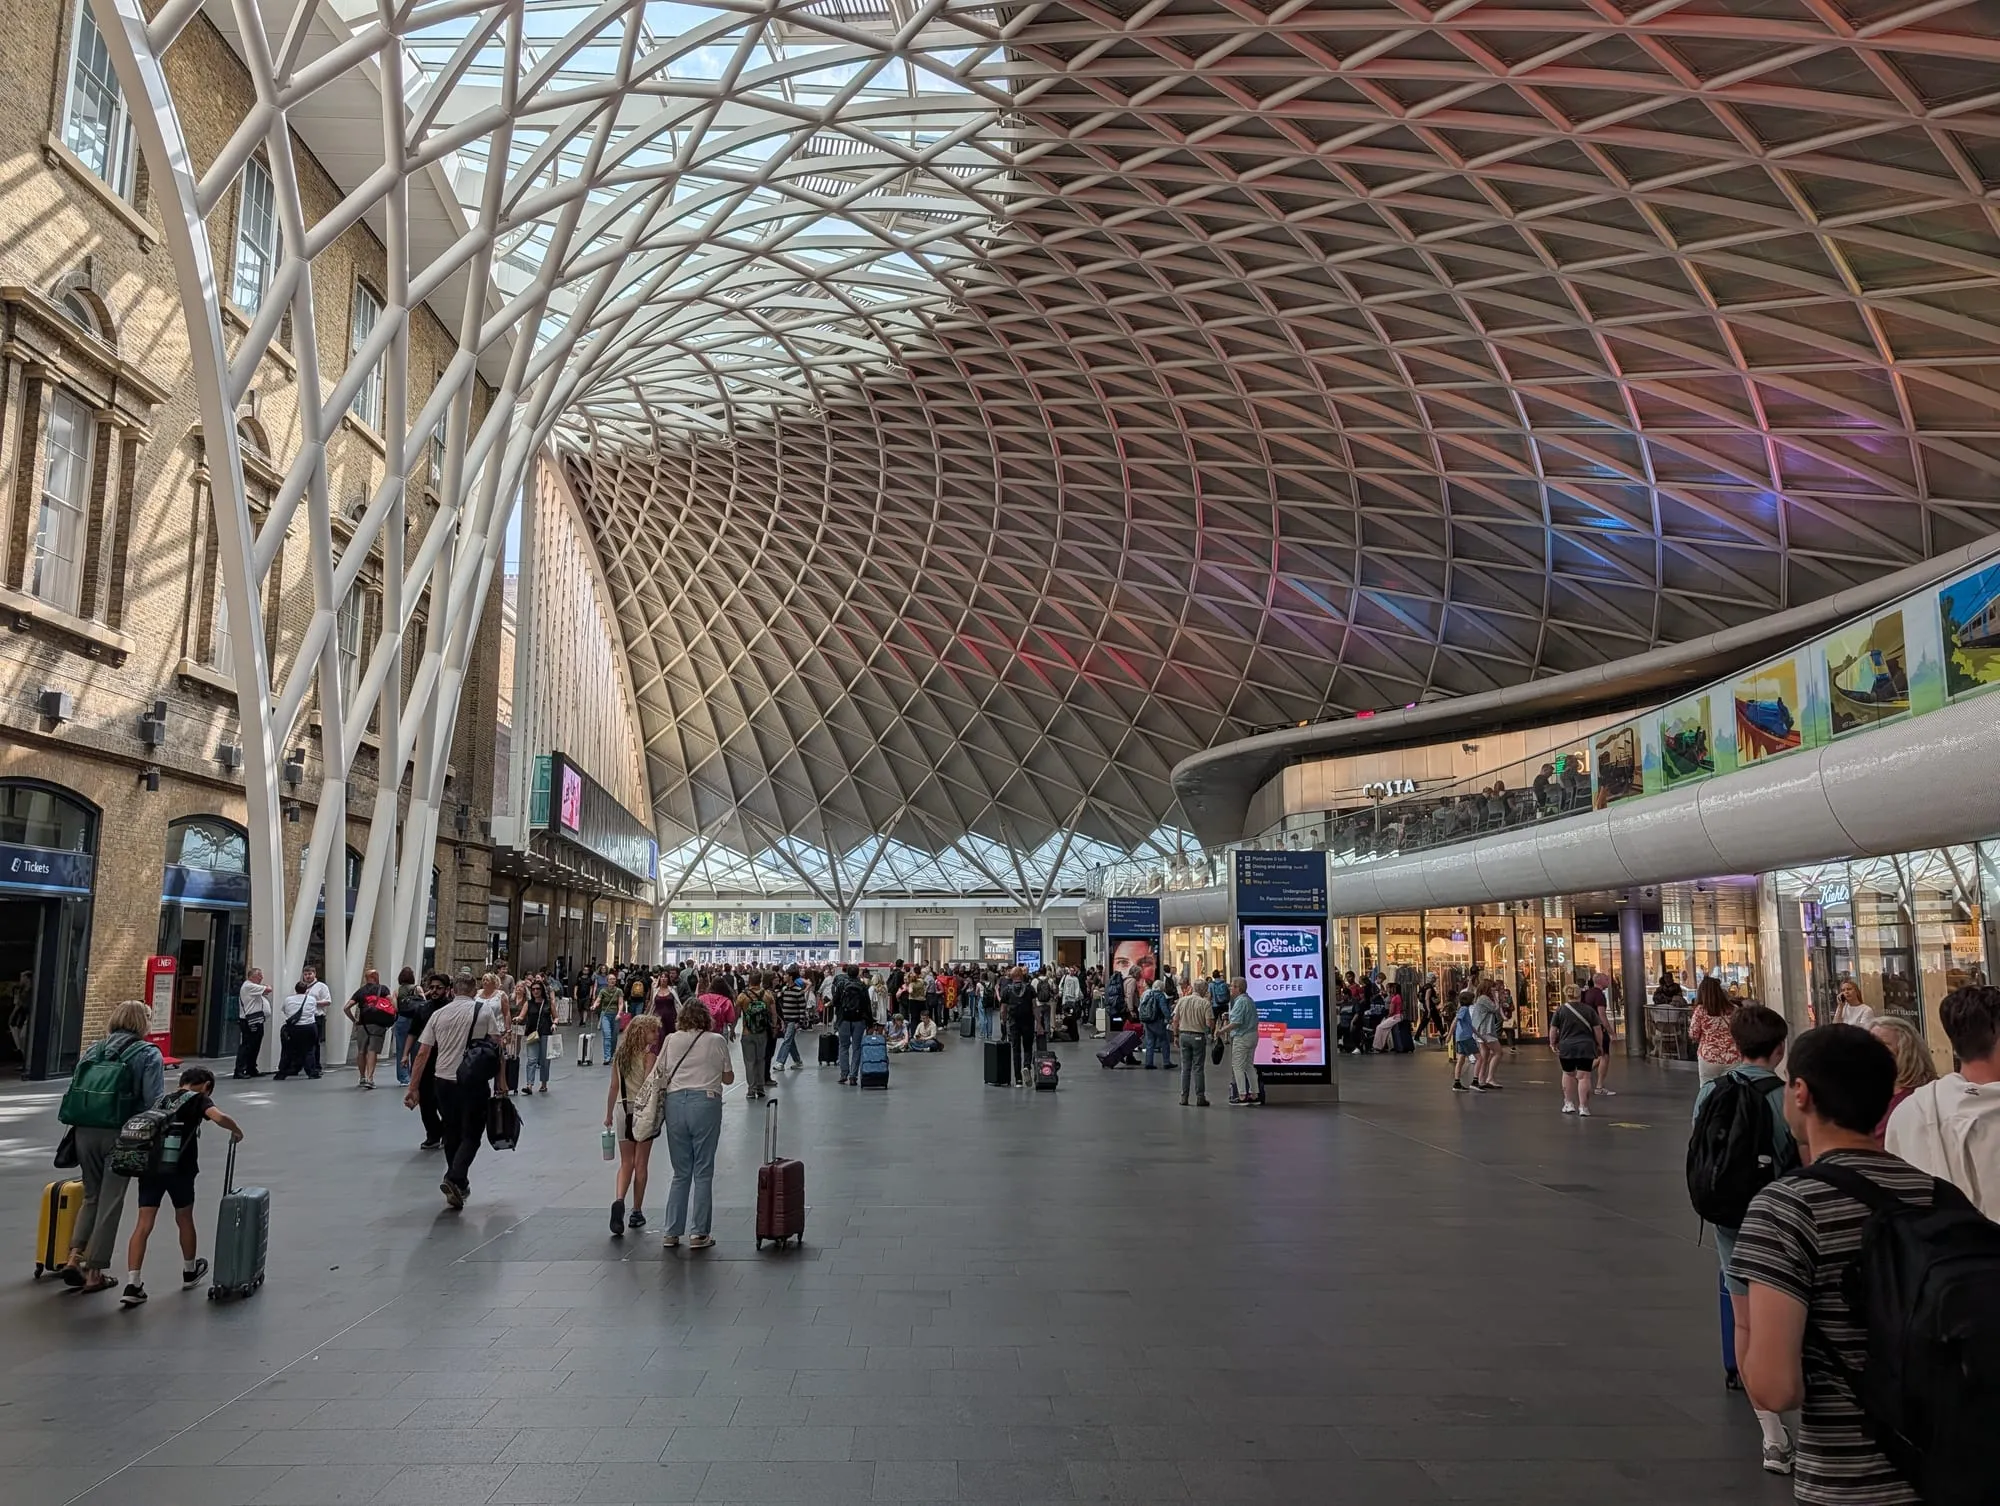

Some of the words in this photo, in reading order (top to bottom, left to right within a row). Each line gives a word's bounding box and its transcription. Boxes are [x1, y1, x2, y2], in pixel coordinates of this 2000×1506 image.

[24, 860, 50, 874] Tickets
[157, 959, 172, 968] LNER
[1249, 964, 1318, 981] COSTA
